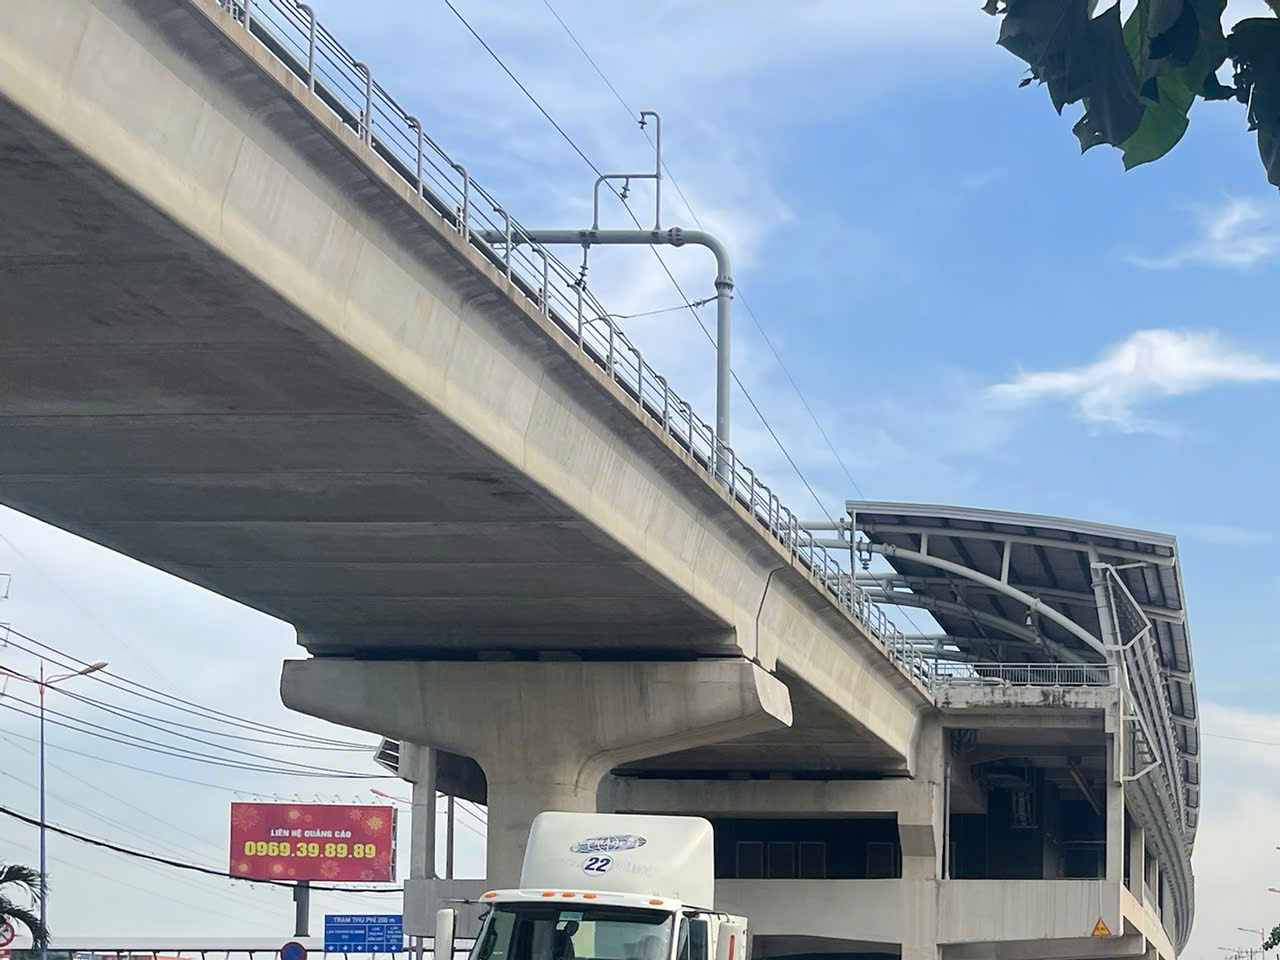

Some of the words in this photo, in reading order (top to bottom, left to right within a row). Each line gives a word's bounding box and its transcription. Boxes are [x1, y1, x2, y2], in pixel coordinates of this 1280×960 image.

[270, 828, 290, 837] LIÊN
[291, 828, 302, 838] HỆ
[304, 828, 333, 838] QUẢNG
[334, 829, 352, 839] CÁO
[244, 841, 376, 859] 0969.39.89.89
[584, 856, 611, 873] 22
